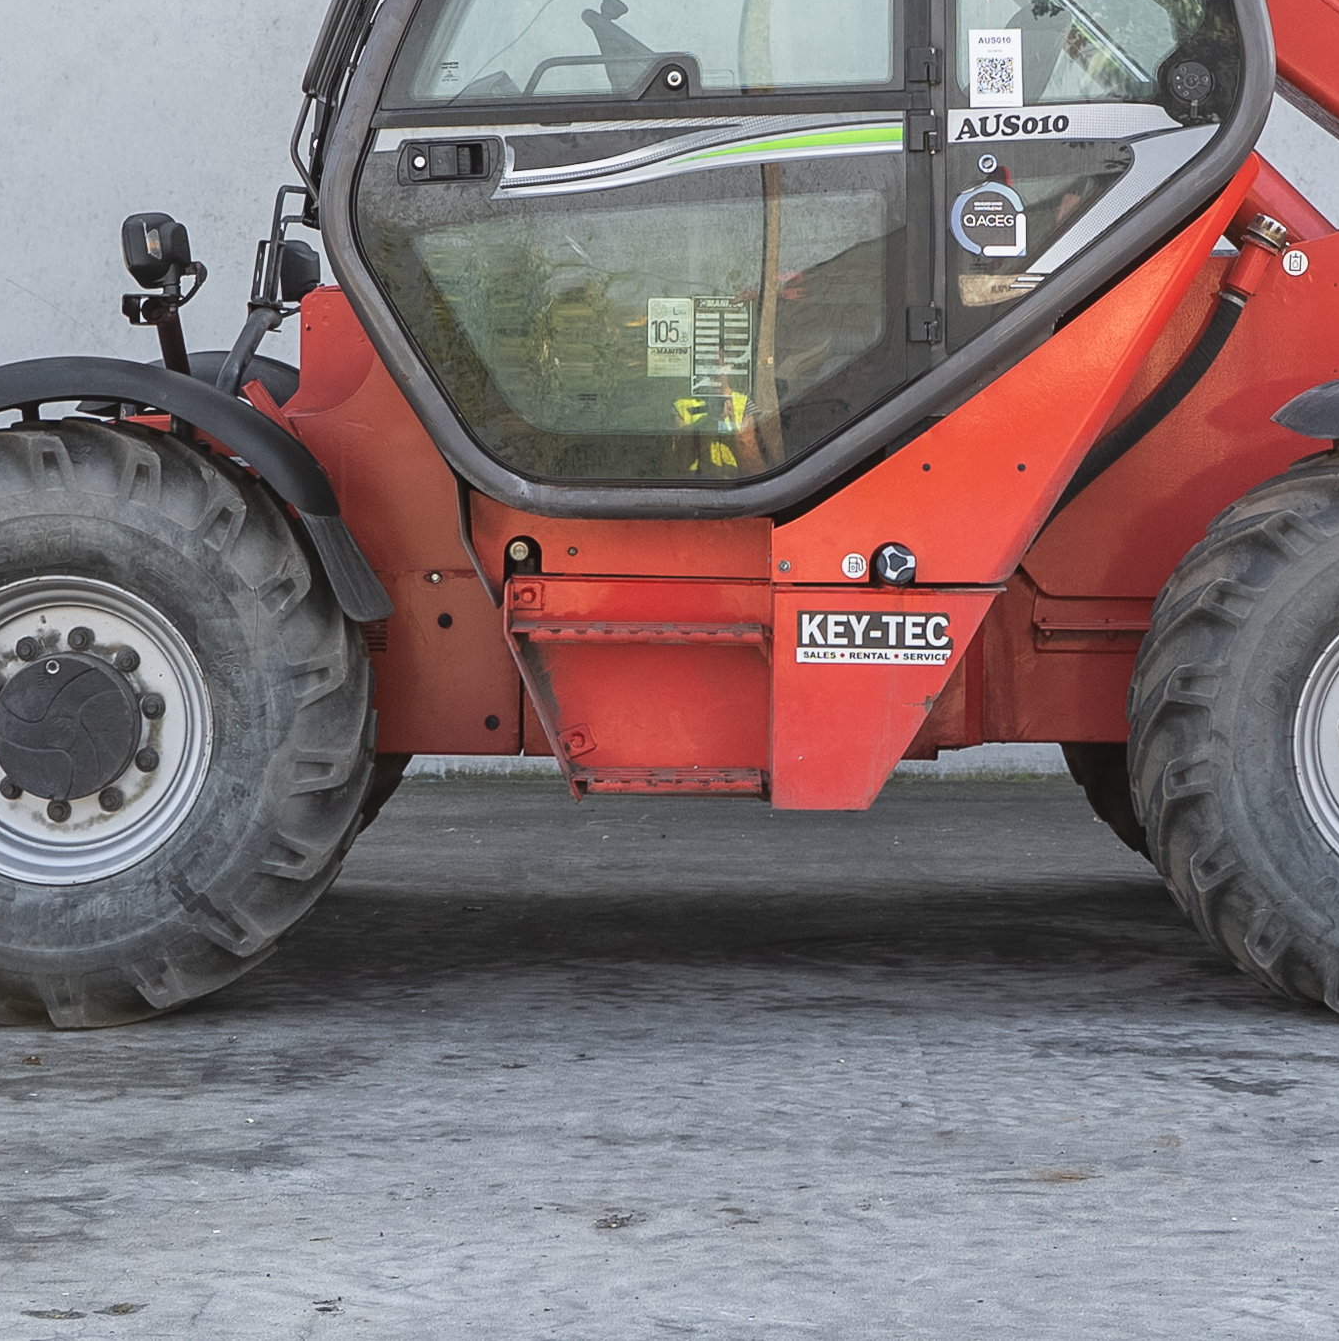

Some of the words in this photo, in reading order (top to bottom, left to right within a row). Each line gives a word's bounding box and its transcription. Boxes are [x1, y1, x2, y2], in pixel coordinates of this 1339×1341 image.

[978, 37, 1012, 45] AUS010
[955, 113, 1069, 141] AUS010
[651, 320, 680, 344] 105
[801, 613, 950, 647] KEY-TEC
[803, 651, 837, 659] SALES
[849, 652, 890, 660] RENTAL
